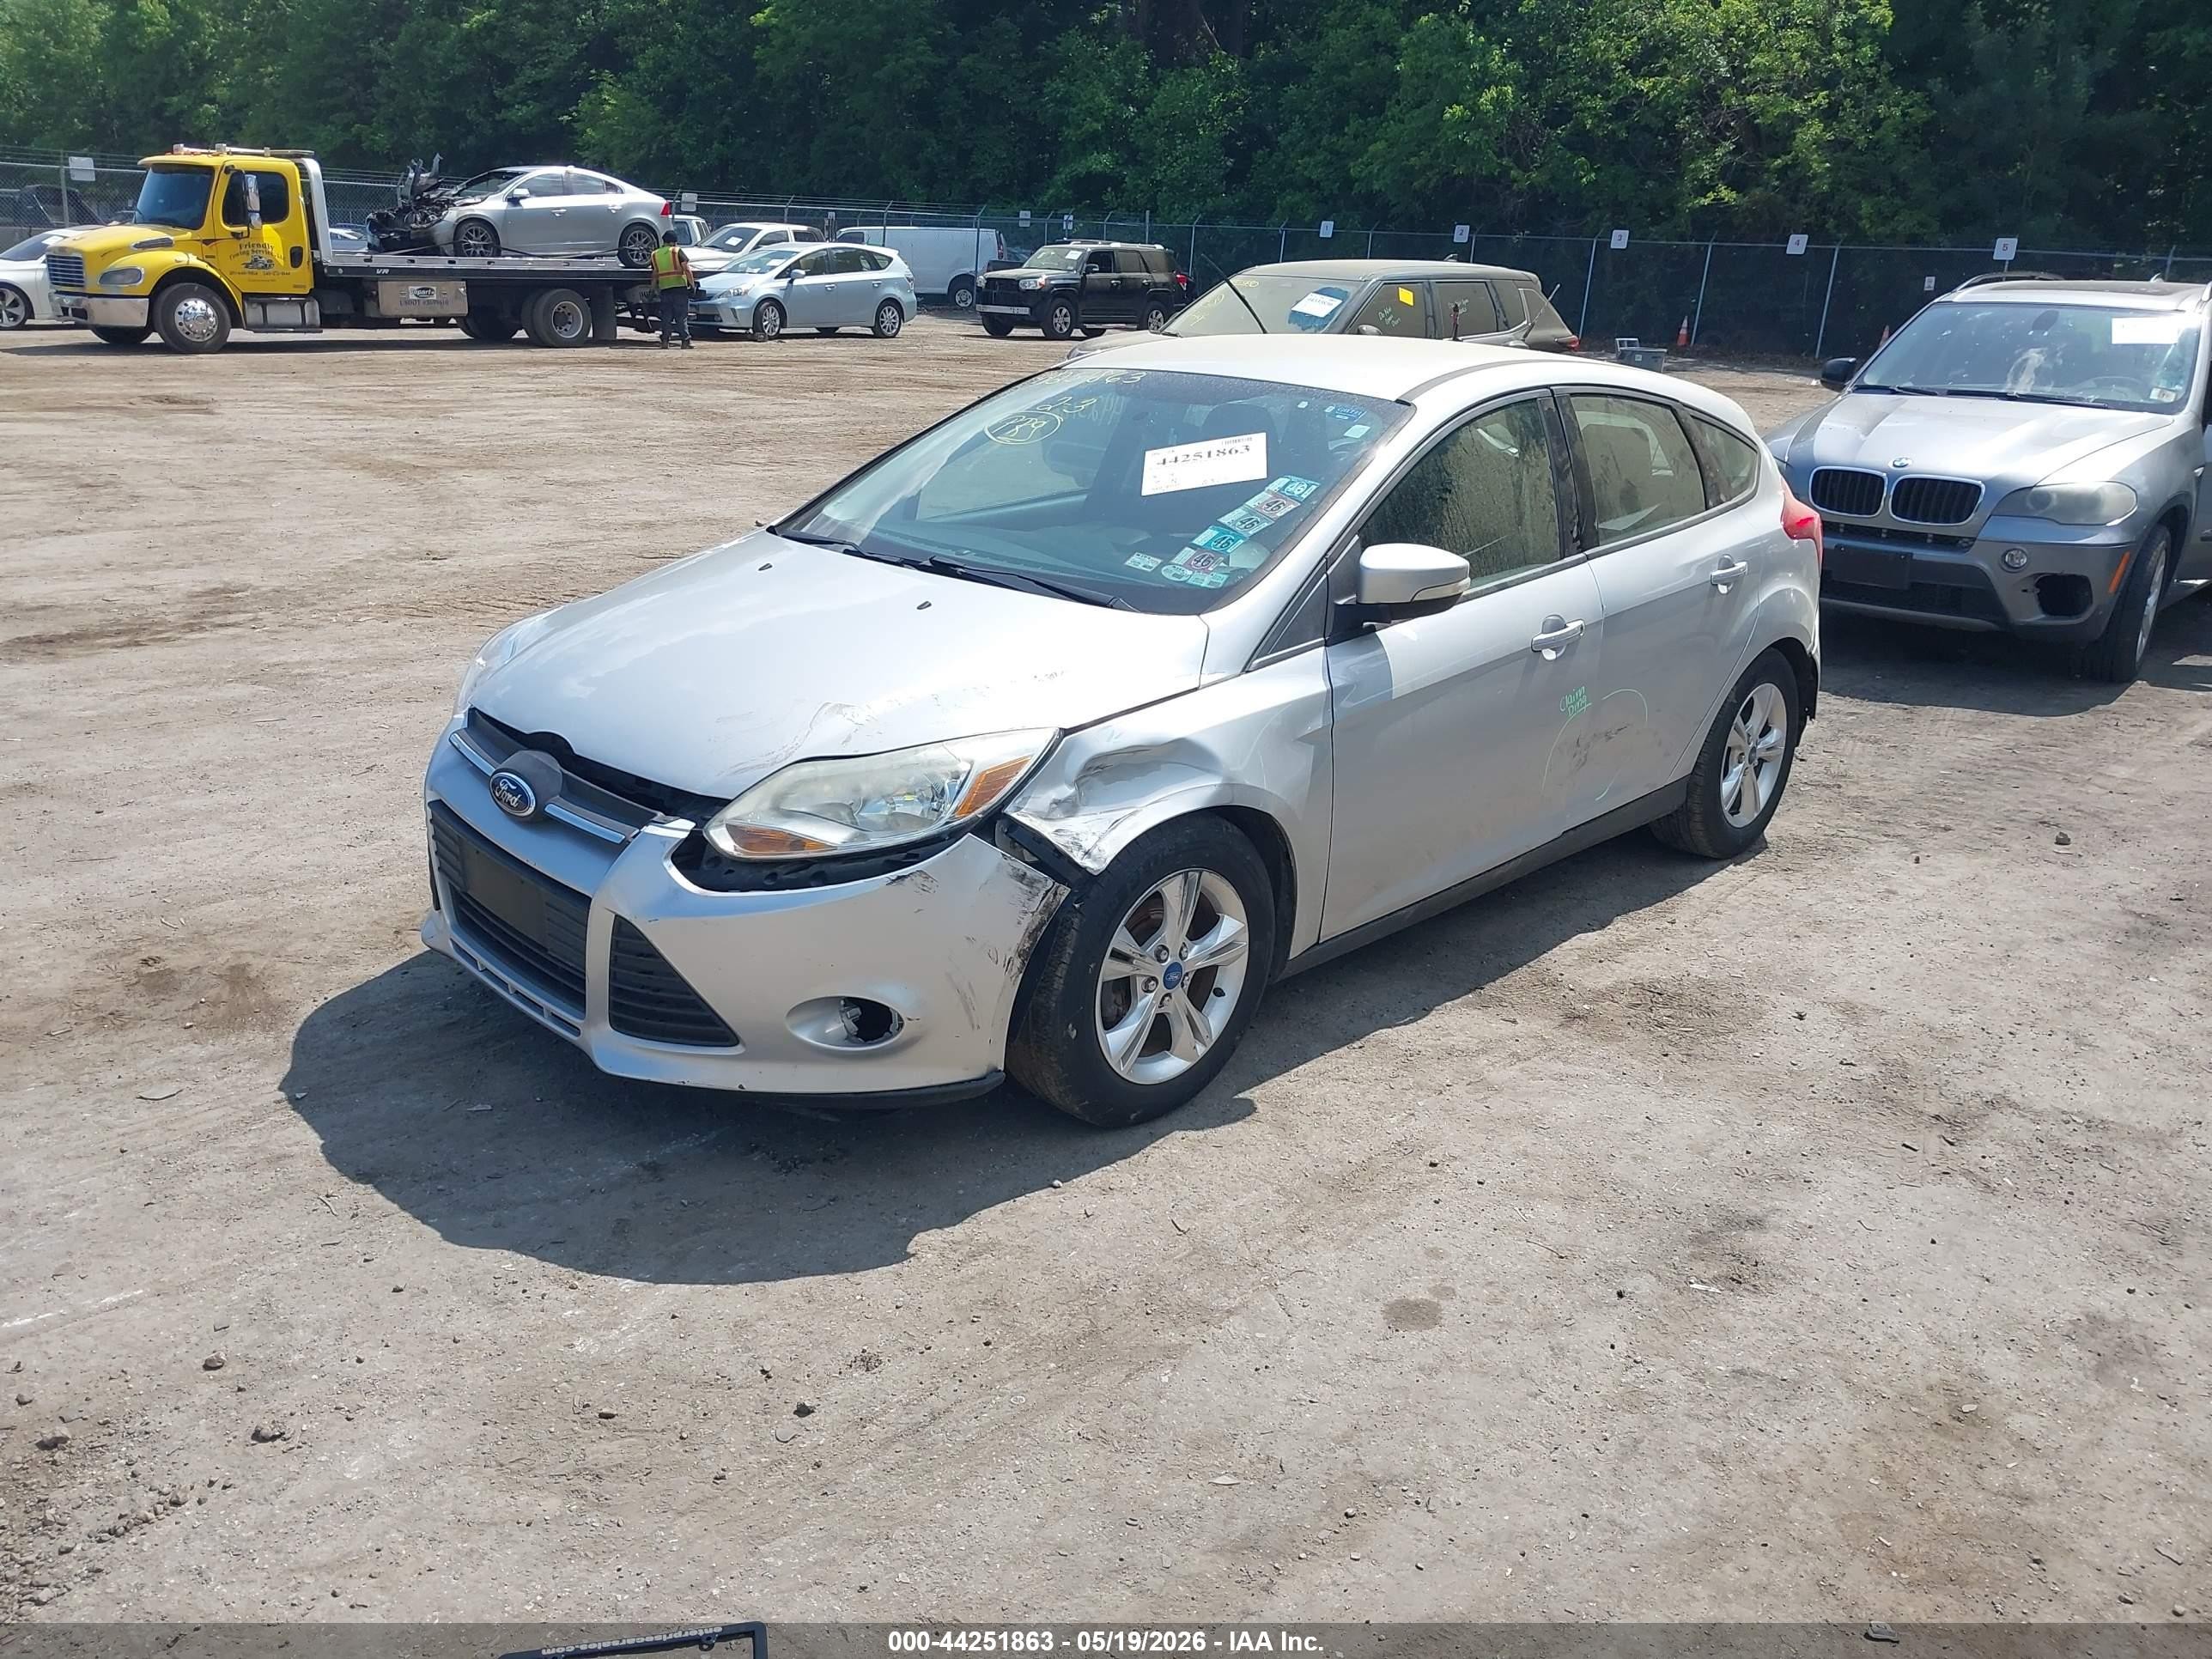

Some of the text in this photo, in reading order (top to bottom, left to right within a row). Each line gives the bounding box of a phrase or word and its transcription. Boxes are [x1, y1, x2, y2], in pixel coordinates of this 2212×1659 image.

[239, 242, 275, 251] Friendly
[1795, 239, 1801, 247] 4
[2002, 243, 2008, 252] 5
[1157, 445, 1250, 465] 44251863
[1266, 500, 1285, 512] 46
[1237, 517, 1260, 529] 46
[1214, 536, 1234, 549] 46
[1194, 554, 1214, 567] 46
[1560, 686, 1585, 712] Claim
[495, 778, 522, 808] Ford
[542, 1626, 723, 1656] enterprisecarsales.com
